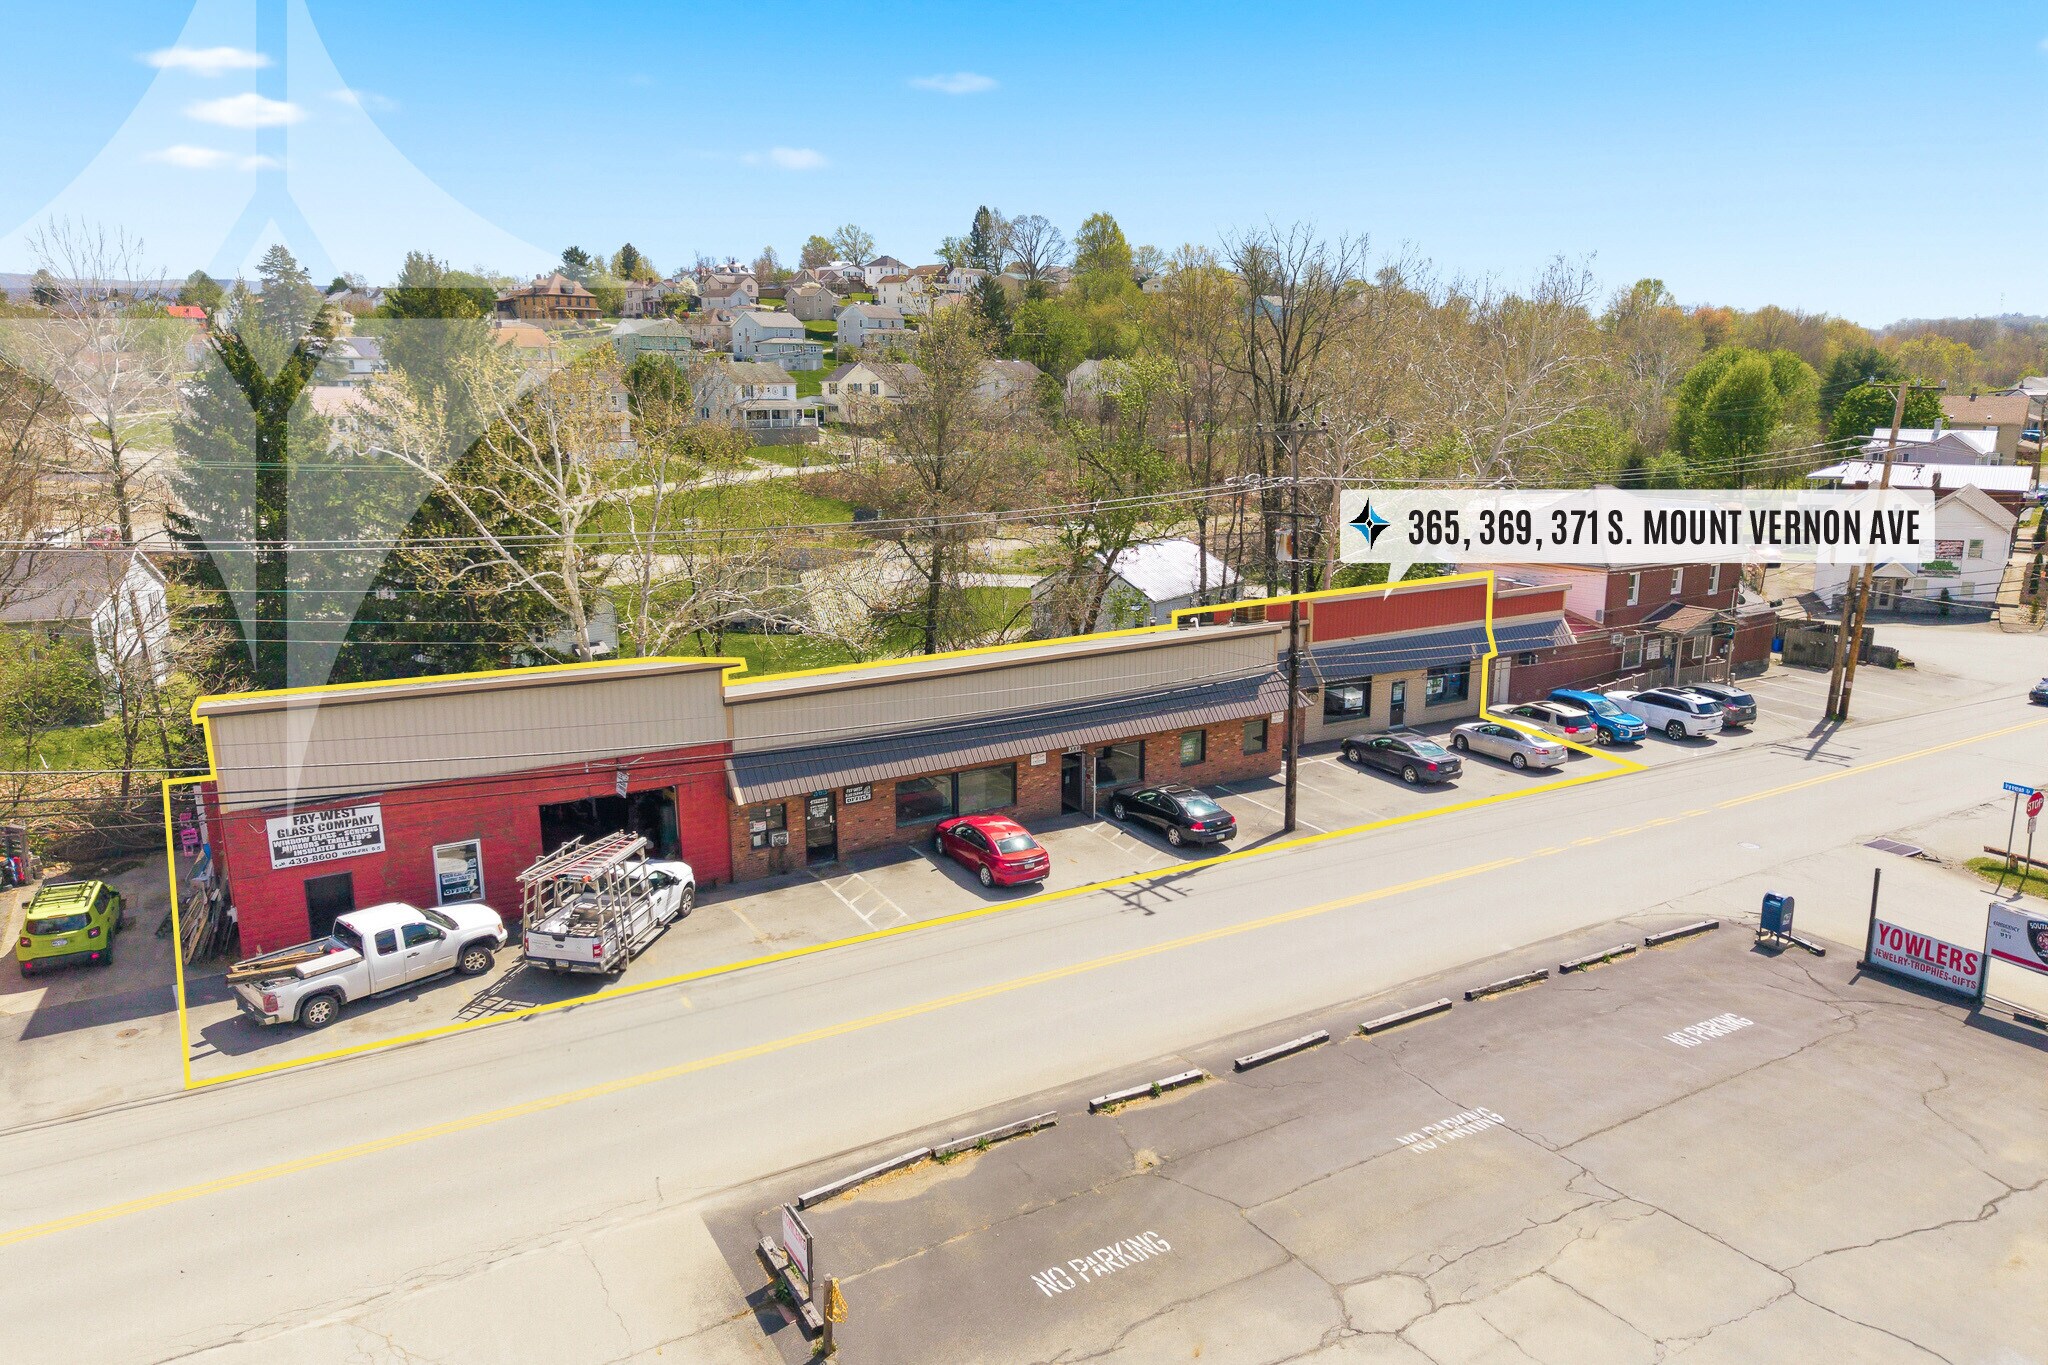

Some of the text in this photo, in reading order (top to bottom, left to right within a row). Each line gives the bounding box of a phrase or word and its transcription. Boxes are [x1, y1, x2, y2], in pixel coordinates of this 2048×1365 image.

[293, 808, 357, 826] FAY-WEST
[2027, 797, 2044, 812] STOP
[277, 815, 374, 838] GLASS COMPANY
[288, 851, 338, 865] 439-8600
[1879, 923, 1978, 976] YOWLERS
[1662, 1012, 1755, 1048] NO PARKING
[1395, 1106, 1506, 1155] NO PARKING
[1030, 1230, 1171, 1298] NO PARKING
